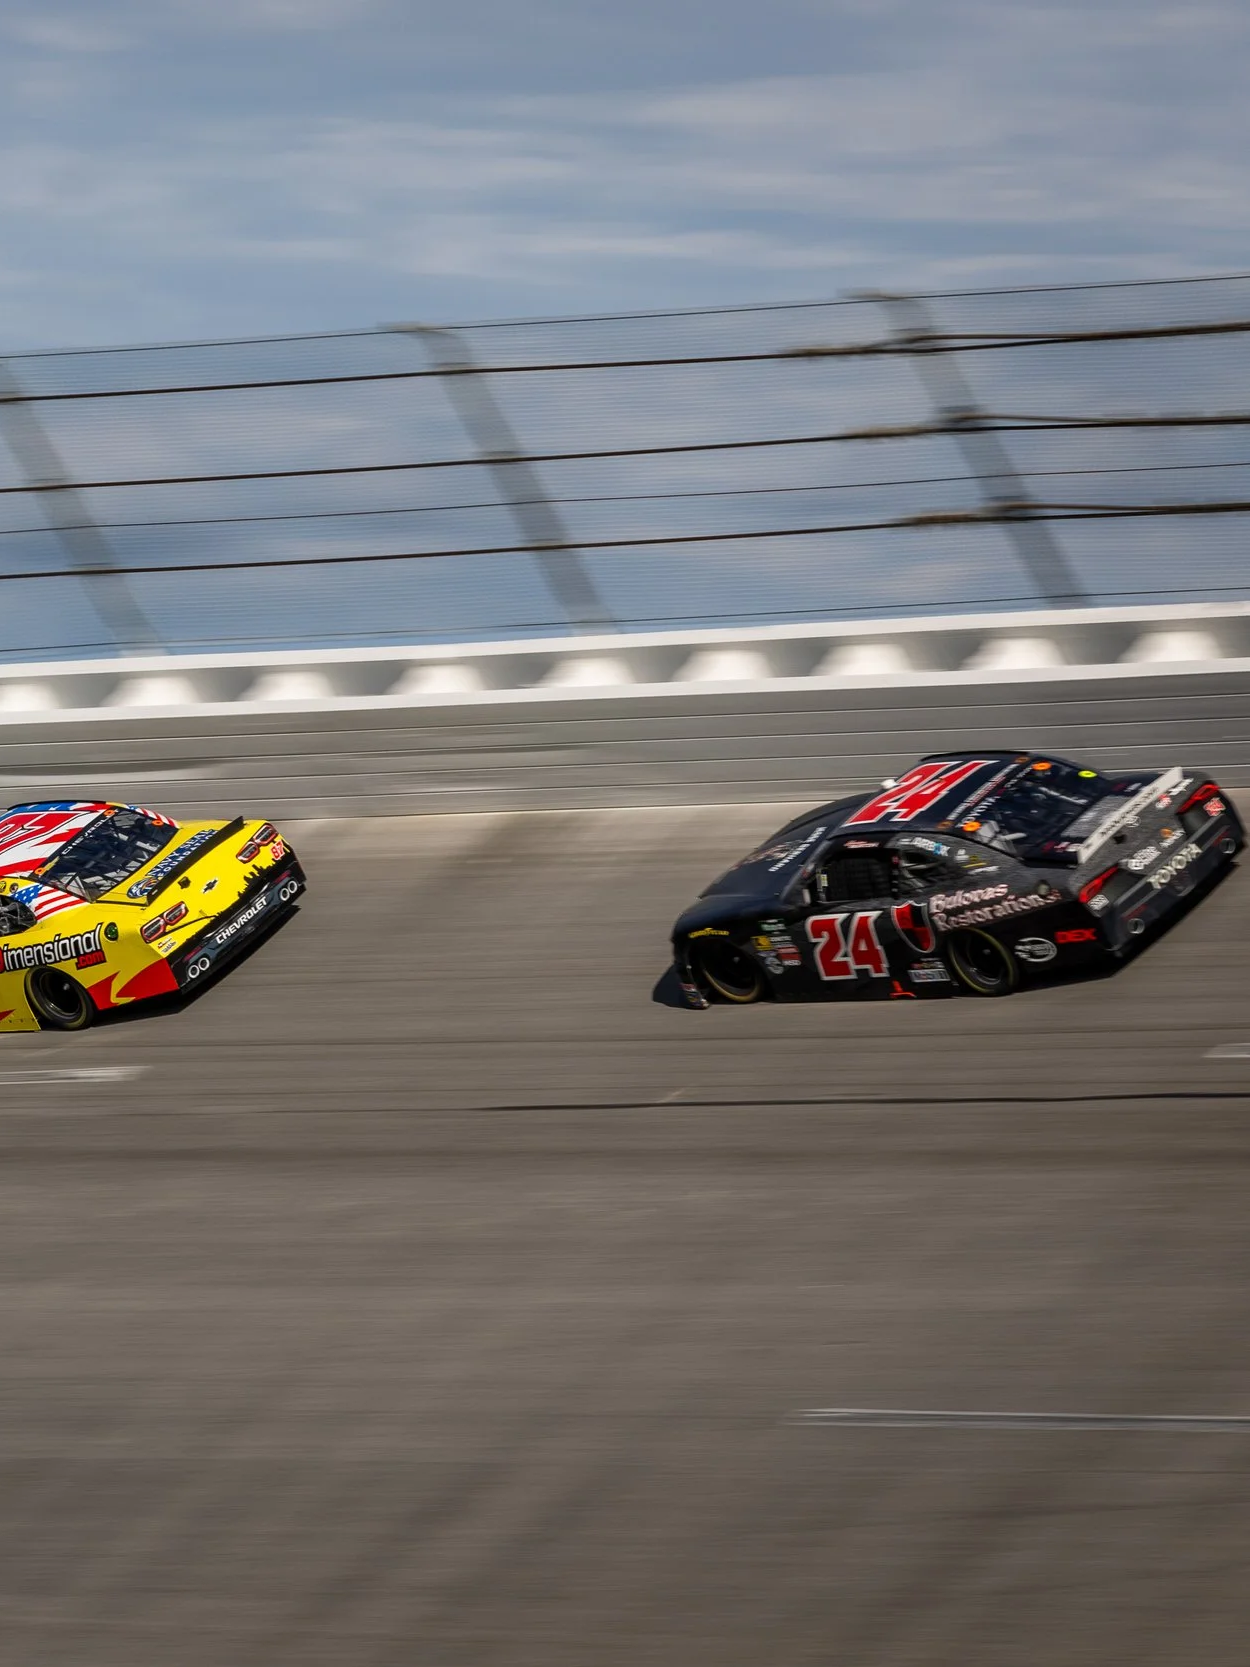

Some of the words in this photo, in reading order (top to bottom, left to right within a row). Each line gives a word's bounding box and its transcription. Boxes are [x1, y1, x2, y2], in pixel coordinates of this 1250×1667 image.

[840, 760, 1001, 828] 24
[146, 851, 181, 877] NAVY
[270, 839, 286, 861] 87
[1146, 843, 1204, 890] TOYOTA
[215, 896, 269, 945] CHEVROLET
[804, 910, 891, 981] 24
